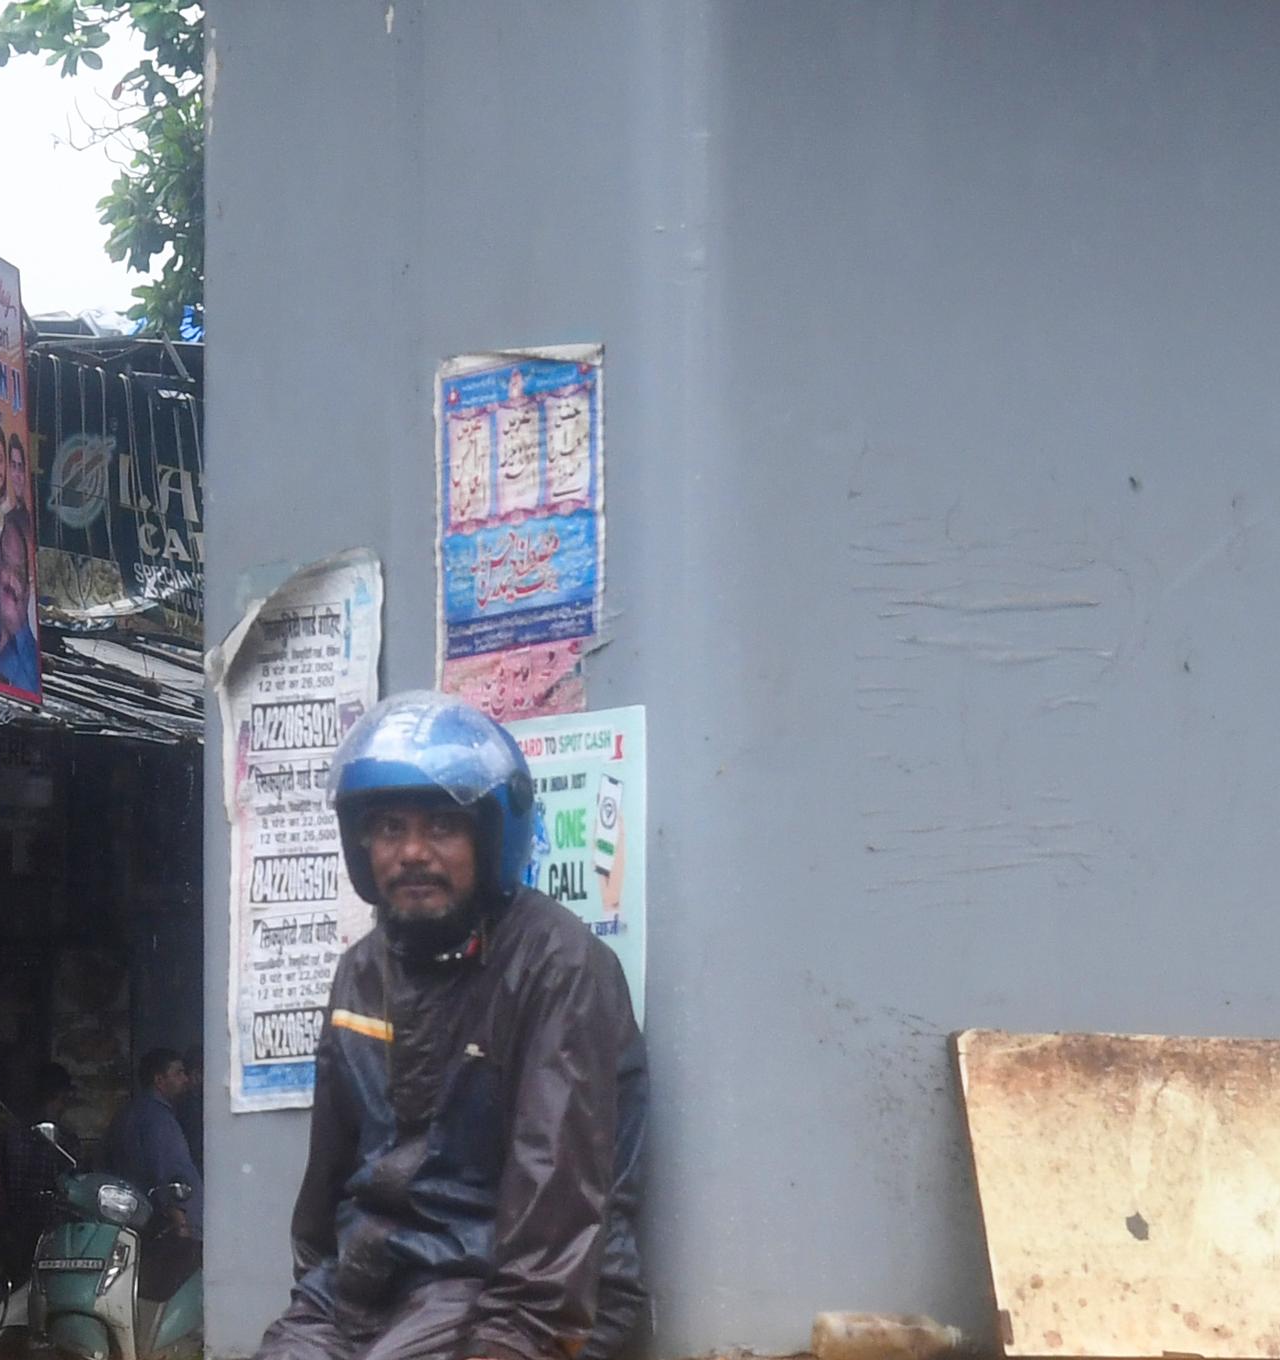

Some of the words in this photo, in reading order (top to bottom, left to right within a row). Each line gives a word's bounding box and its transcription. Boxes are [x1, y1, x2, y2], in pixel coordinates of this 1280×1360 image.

[262, 664, 270, 678] 8
[258, 679, 272, 693] 12
[301, 675, 336, 690] 26,500
[253, 702, 336, 749] 8422065912
[544, 736, 557, 755] TO
[559, 733, 584, 754] SPOT
[585, 729, 612, 751] CASH
[263, 817, 270, 830] 8
[555, 808, 587, 851] ONE
[260, 832, 271, 846] 12
[302, 826, 338, 842] 26,500
[252, 857, 338, 902] 8422065912
[549, 861, 588, 902] CALL
[260, 973, 267, 985] 8
[299, 967, 331, 983] 22,000
[257, 987, 270, 1001] 12
[254, 1010, 324, 1058] 84220659
